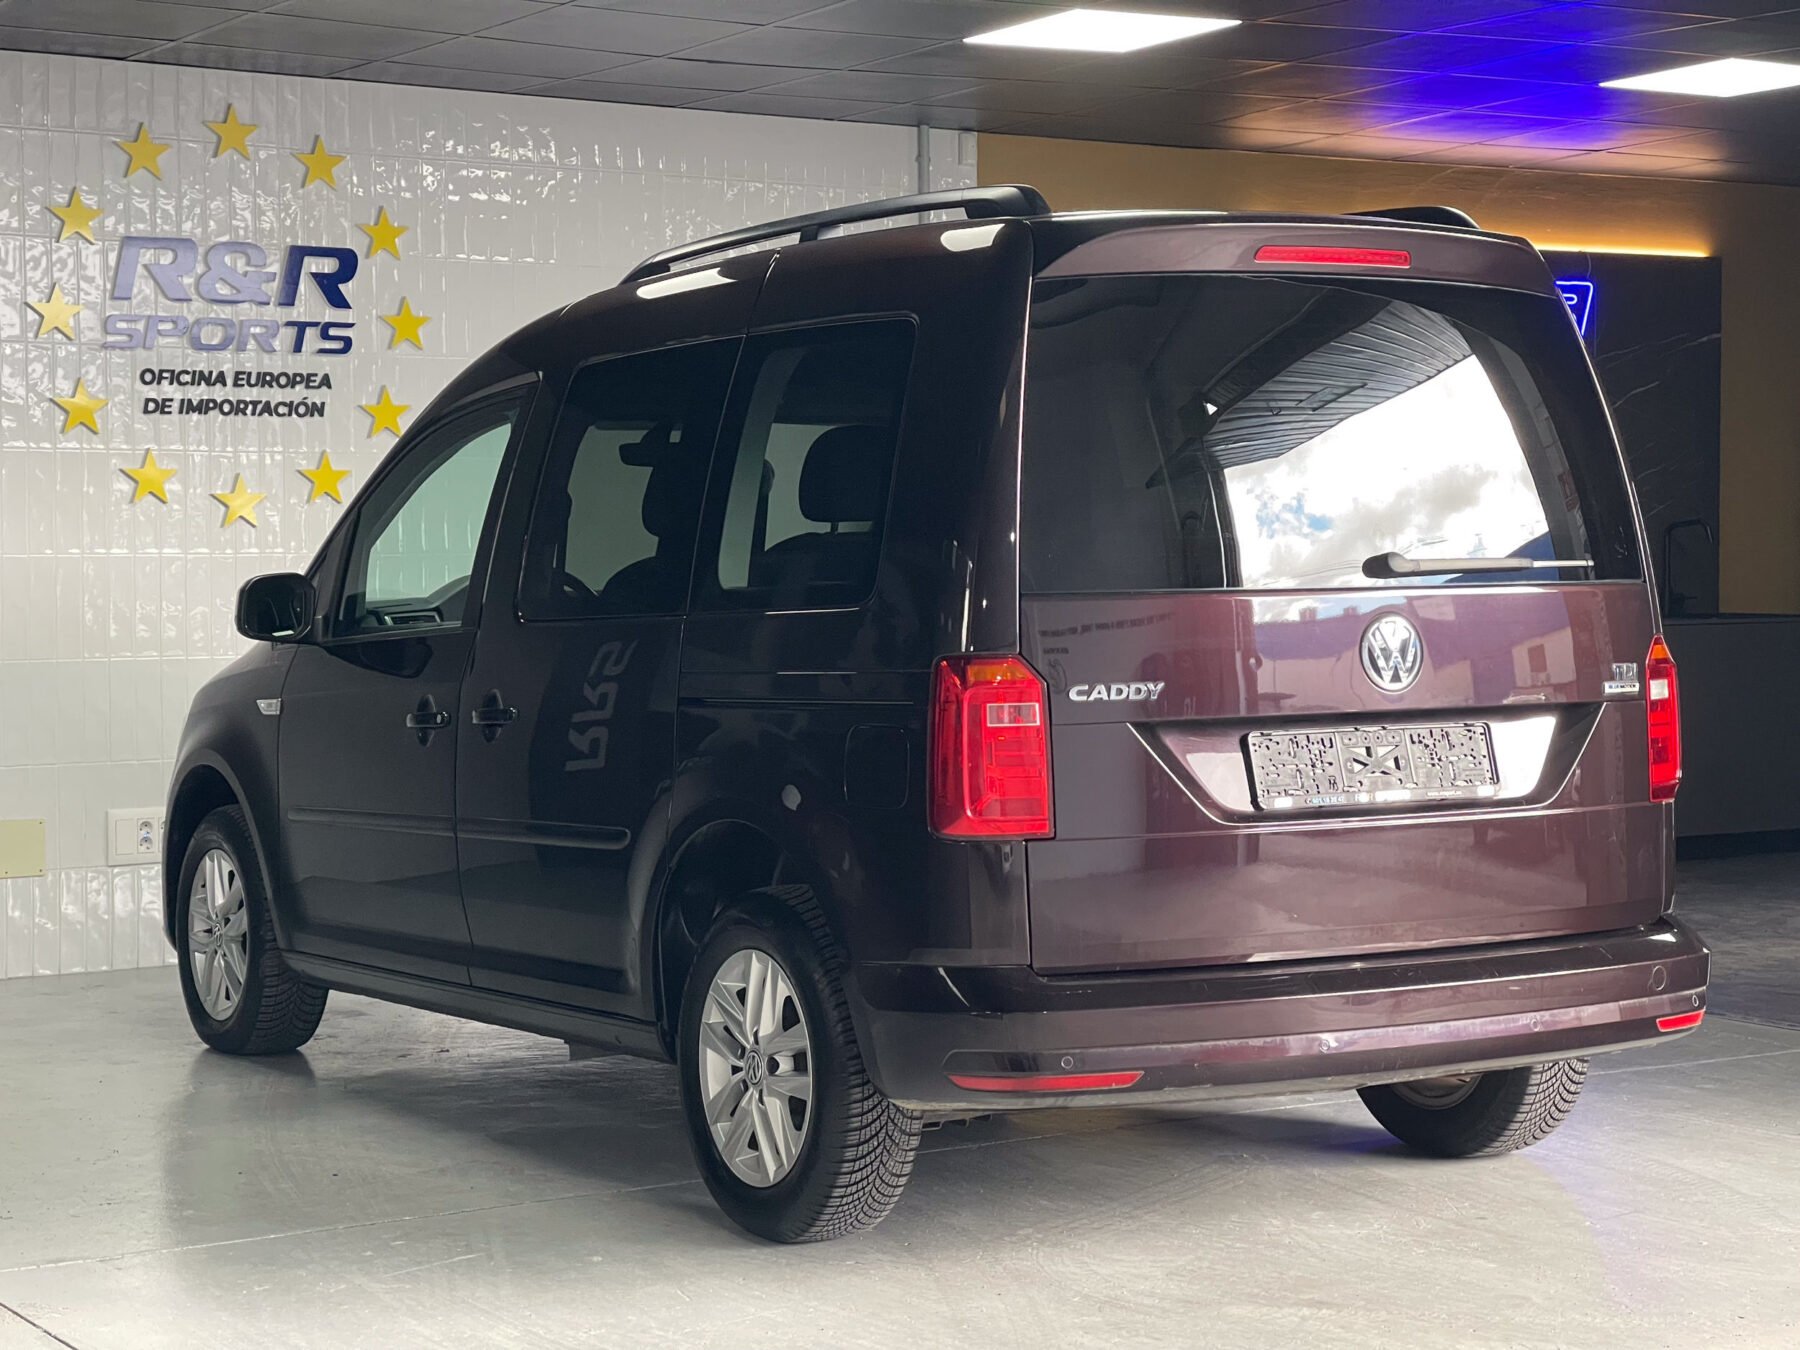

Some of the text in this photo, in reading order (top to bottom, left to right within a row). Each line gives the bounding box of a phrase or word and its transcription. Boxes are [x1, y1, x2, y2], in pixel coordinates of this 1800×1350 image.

[111, 236, 359, 310] R&R
[103, 315, 356, 355] SPORTS
[139, 368, 332, 389] OFICINA EUROPEA
[142, 397, 326, 418] DE IMPORTACIÓN
[1068, 681, 1165, 701] CADDY
